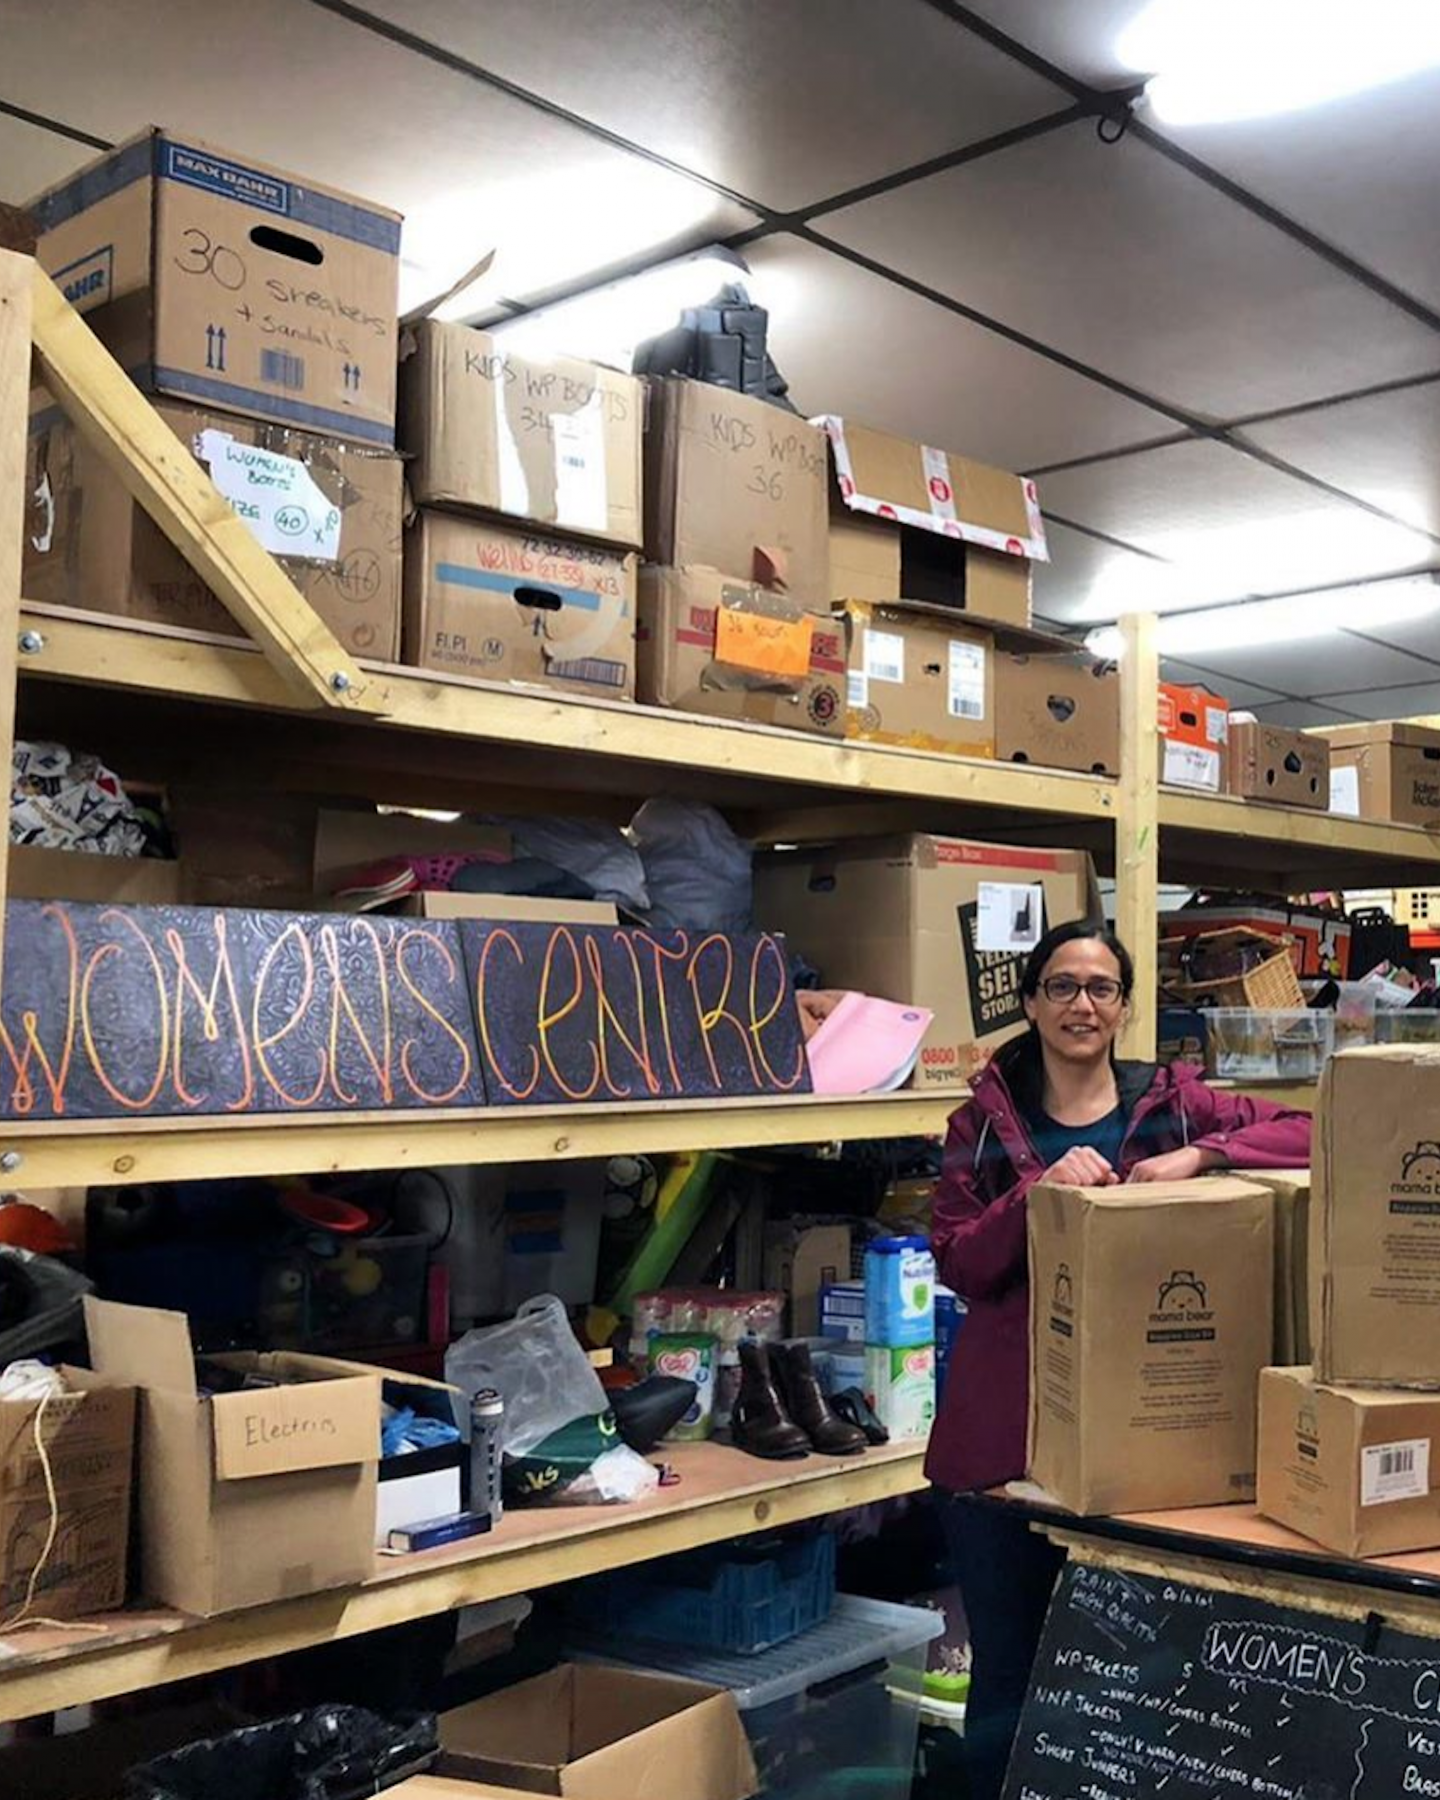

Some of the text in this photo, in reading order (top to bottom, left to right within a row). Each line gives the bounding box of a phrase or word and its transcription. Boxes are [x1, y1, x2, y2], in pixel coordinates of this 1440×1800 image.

[176, 155, 219, 180] MAX
[222, 171, 279, 199] BAHR
[174, 228, 246, 291] 30
[64, 269, 105, 302] AHR
[465, 350, 517, 384] KIDS
[711, 412, 757, 452] KIDS
[745, 464, 783, 501] 36
[278, 510, 301, 531] 40
[921, 1048, 955, 1065] 0800
[1391, 1183, 1431, 1195] mama
[1149, 1309, 1215, 1323] mama bear
[1054, 1649, 1082, 1668] WP
[1181, 1661, 1194, 1679] S
[1209, 1628, 1367, 1697] WOMEN'S
